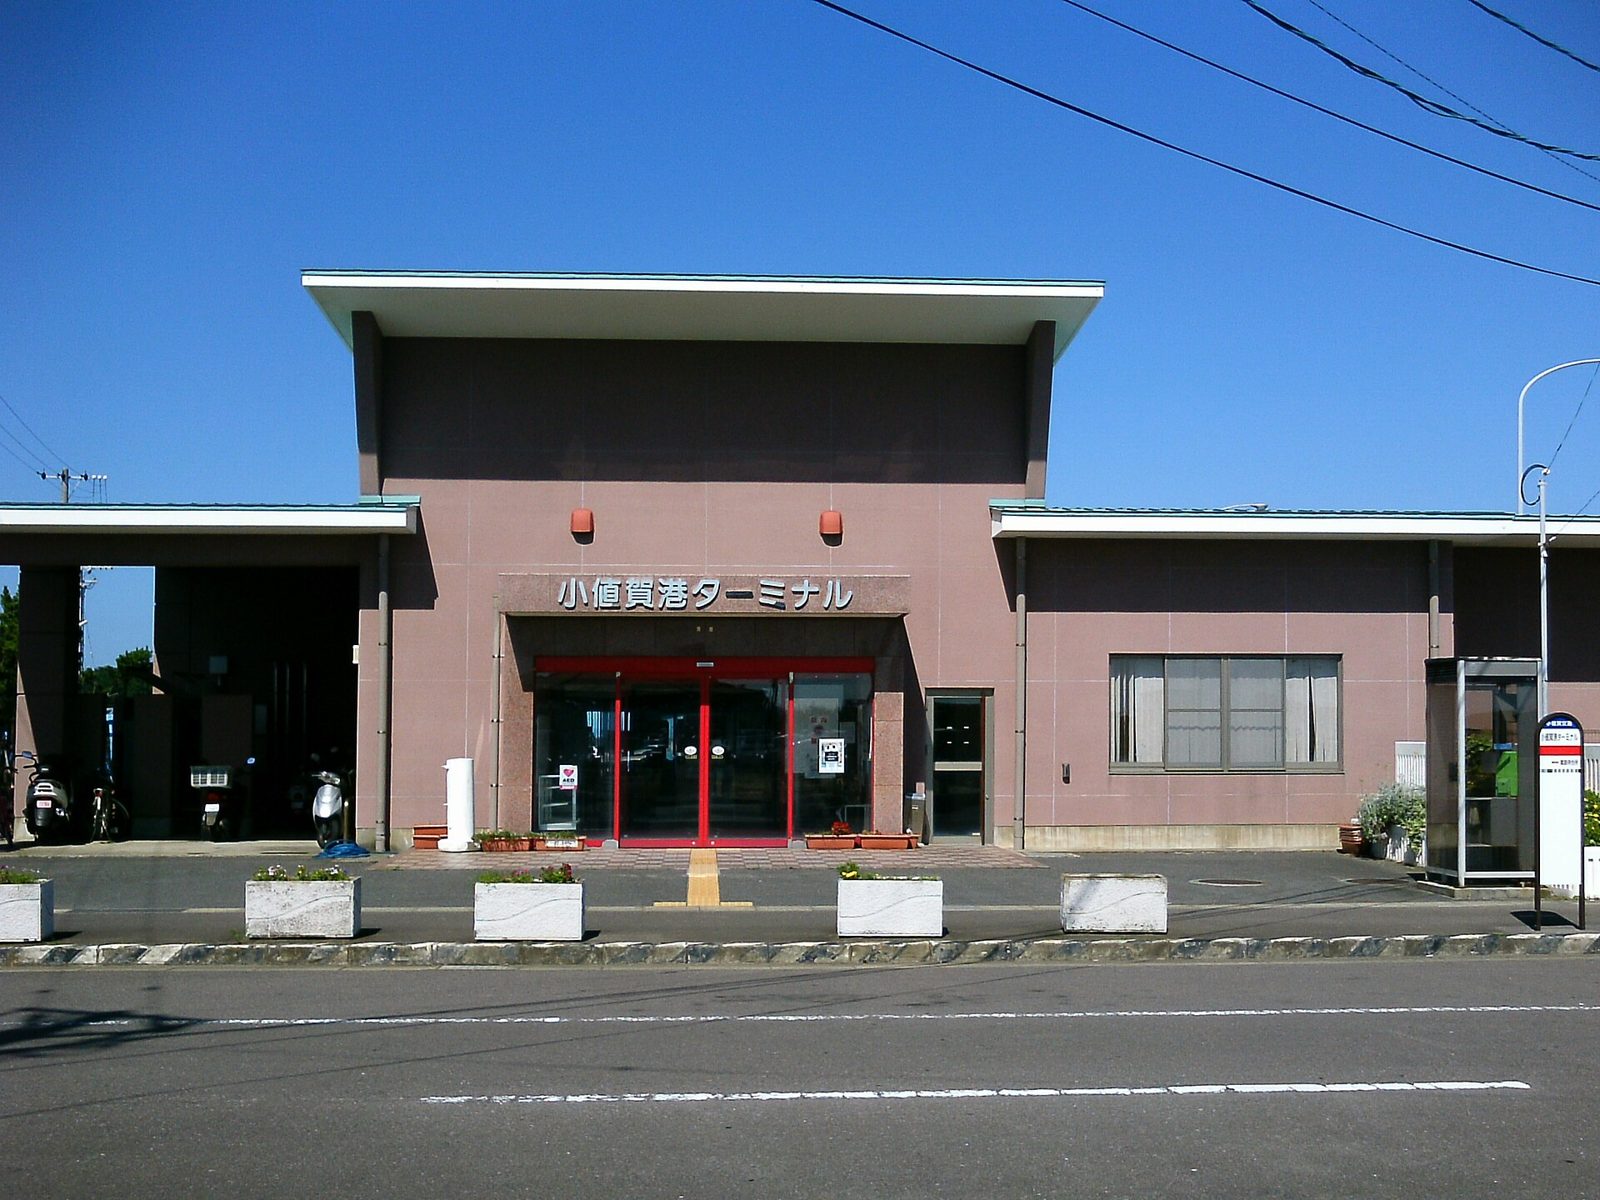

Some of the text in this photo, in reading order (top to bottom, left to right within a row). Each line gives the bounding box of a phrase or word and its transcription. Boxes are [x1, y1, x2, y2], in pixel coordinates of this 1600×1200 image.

[558, 577, 853, 609] 小値賀港ターミナル
